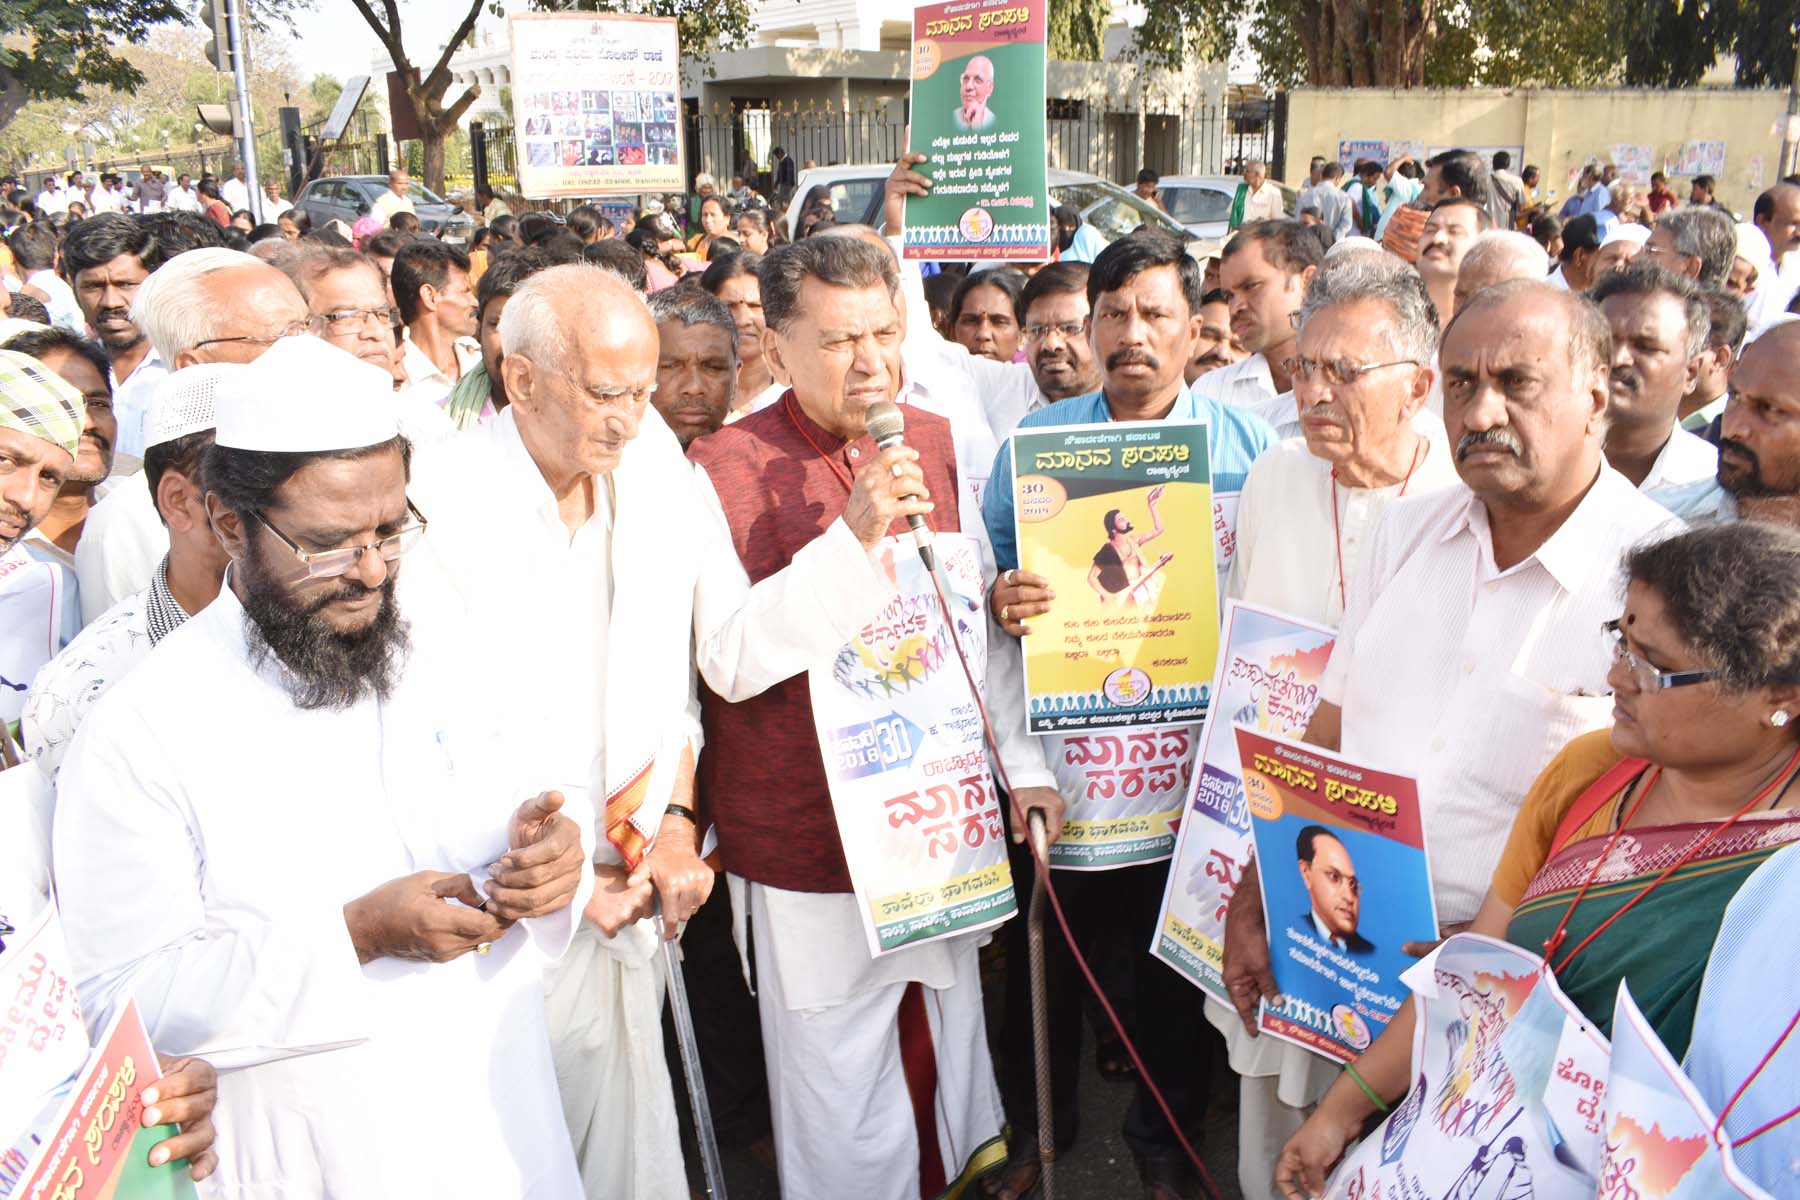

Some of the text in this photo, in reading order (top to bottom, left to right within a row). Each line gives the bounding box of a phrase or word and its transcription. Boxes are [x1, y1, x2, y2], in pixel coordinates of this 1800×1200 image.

[925, 6, 1030, 37] ಮಾನವ ಸರಪಳಿ
[1065, 434, 1122, 446] ಸೌಹಾರ್ದತೆಗಾಗಿ
[1035, 443, 1190, 472] ಮಾನವ ಸರಪಳಿ
[1146, 465, 1190, 479] ರಾಜ್ಯಾದ್ಯಂತ
[1022, 483, 1044, 495] 30
[877, 717, 913, 765] 30
[1063, 728, 1190, 767] ಮಾನವ
[1200, 772, 1236, 798] ಜನವರಿ
[1254, 753, 1398, 815] ಮಾನವ ಸರಪಳಿ
[884, 772, 997, 829] ಮಾನ
[1198, 789, 1230, 814] 2018
[922, 808, 1005, 859] ಸರಪ
[83, 1056, 137, 1166] ಸರಪಳಿ
